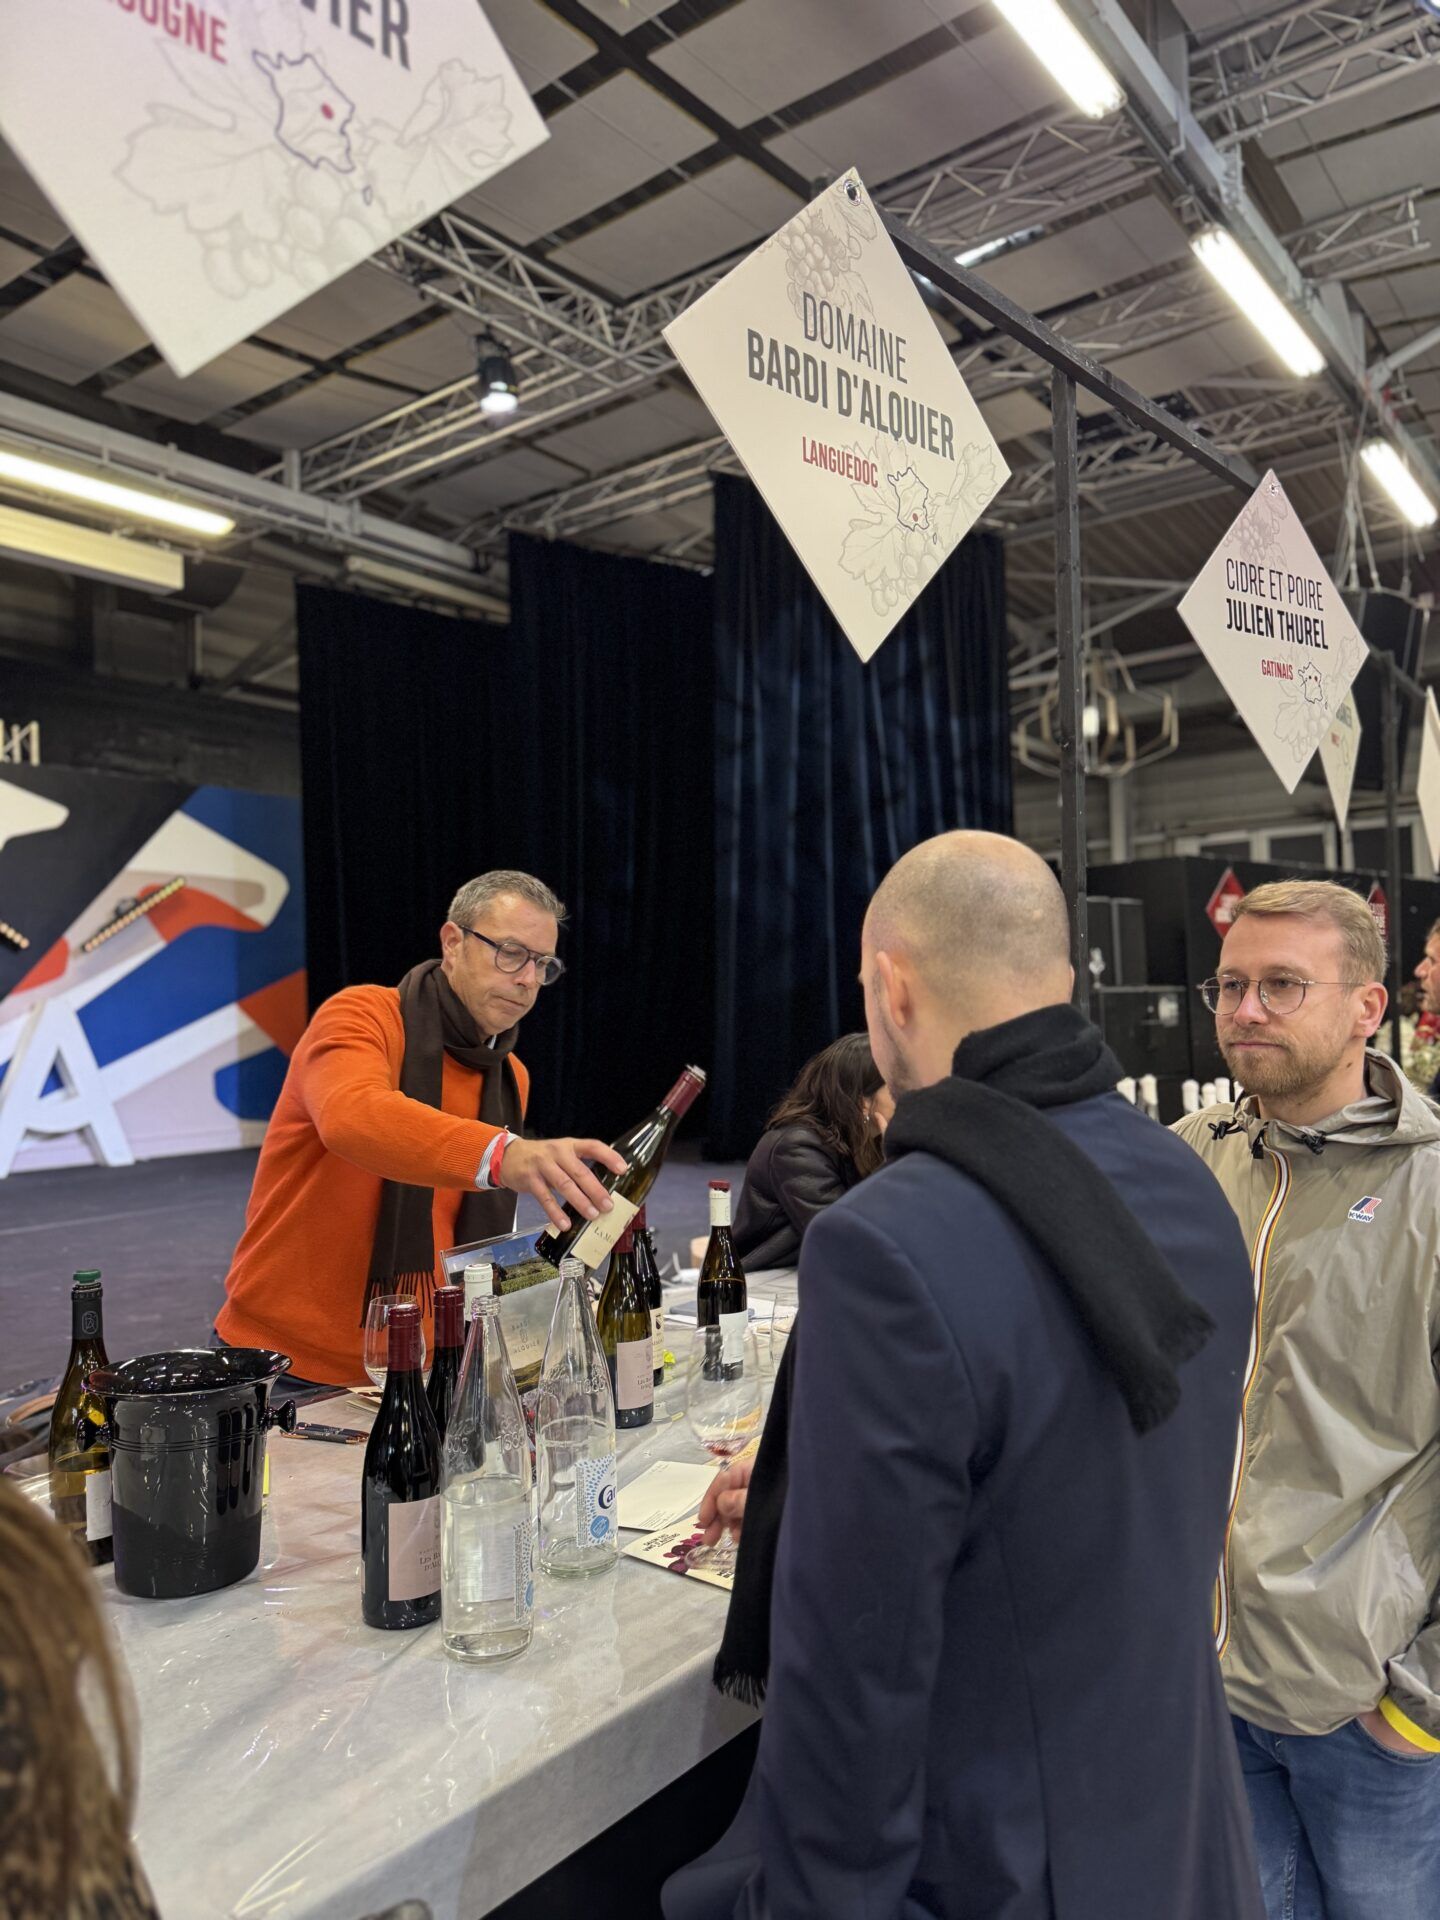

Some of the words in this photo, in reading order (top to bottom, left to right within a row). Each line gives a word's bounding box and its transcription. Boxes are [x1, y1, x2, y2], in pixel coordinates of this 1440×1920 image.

[802, 291, 908, 385] DOMAINE
[747, 328, 829, 410] BARDI
[836, 366, 955, 462] D'ALQUIER
[802, 436, 879, 489] LANGUEDOC
[1226, 558, 1266, 598] CIDRE
[1269, 569, 1283, 602] ET
[1287, 574, 1324, 612] POIRE
[1226, 598, 1275, 639] JULIEN
[1277, 610, 1329, 650] THUREL
[1261, 659, 1294, 681] GATINAIS
